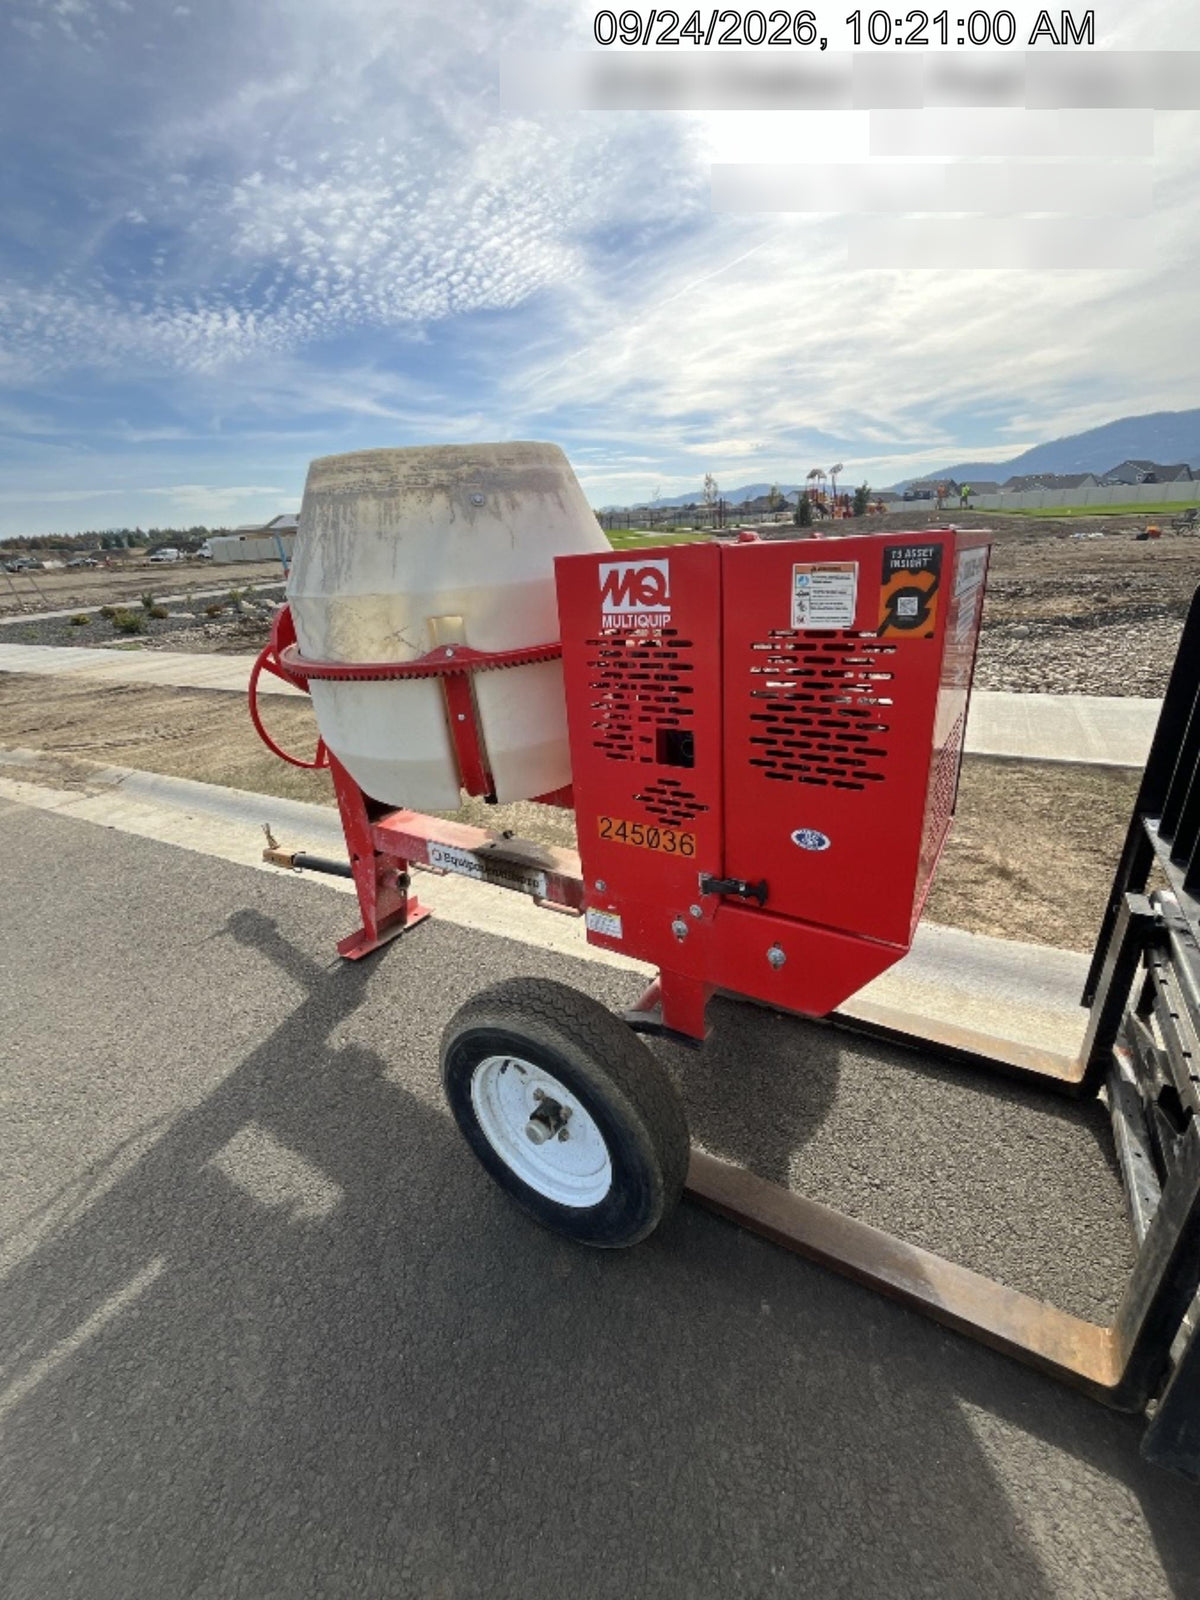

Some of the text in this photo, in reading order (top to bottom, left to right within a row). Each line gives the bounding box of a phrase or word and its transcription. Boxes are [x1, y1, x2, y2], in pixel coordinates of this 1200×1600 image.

[904, 548, 934, 558] ASSET
[890, 558, 929, 568] INSIGHT
[600, 566, 669, 607] MQ
[602, 613, 671, 628] MULTIQUIP
[600, 817, 695, 856] 245036
